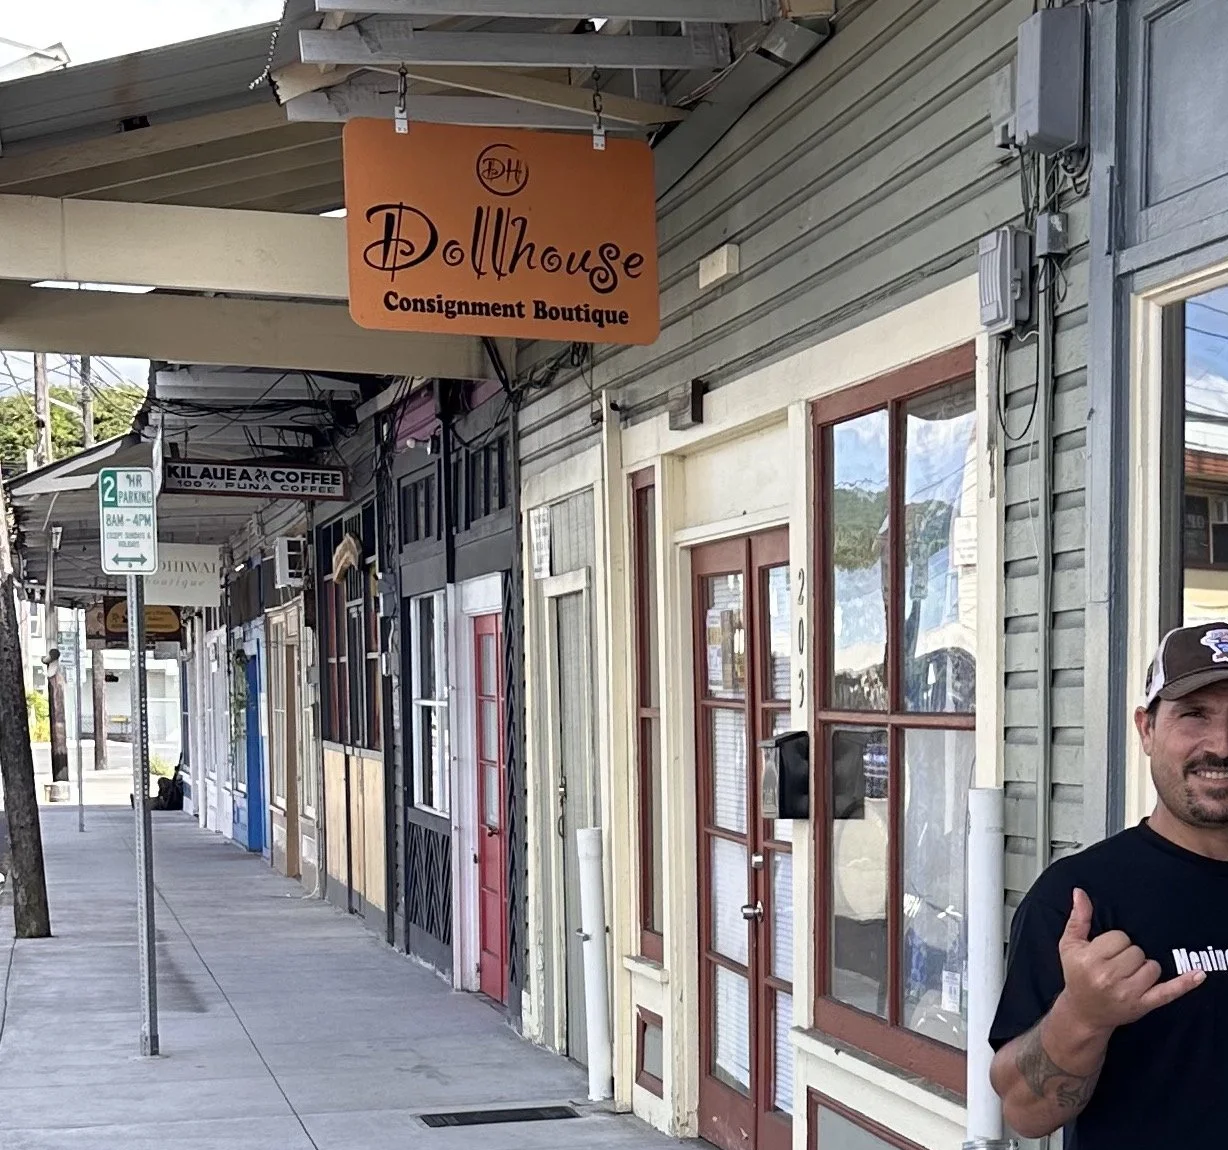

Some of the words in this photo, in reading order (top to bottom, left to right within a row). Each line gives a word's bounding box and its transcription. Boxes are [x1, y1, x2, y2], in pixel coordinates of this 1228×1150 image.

[481, 157, 523, 184] DH
[363, 201, 645, 294] Dollhouse
[383, 290, 525, 319] Consignment
[533, 299, 629, 328] Boutique
[103, 475, 115, 501] 2
[128, 474, 142, 487] HR
[167, 465, 251, 481] KILAUEA
[270, 470, 341, 485] COFFEE
[225, 481, 272, 491] PUNA
[280, 484, 336, 494] COFFEE
[118, 490, 152, 504] PARKING
